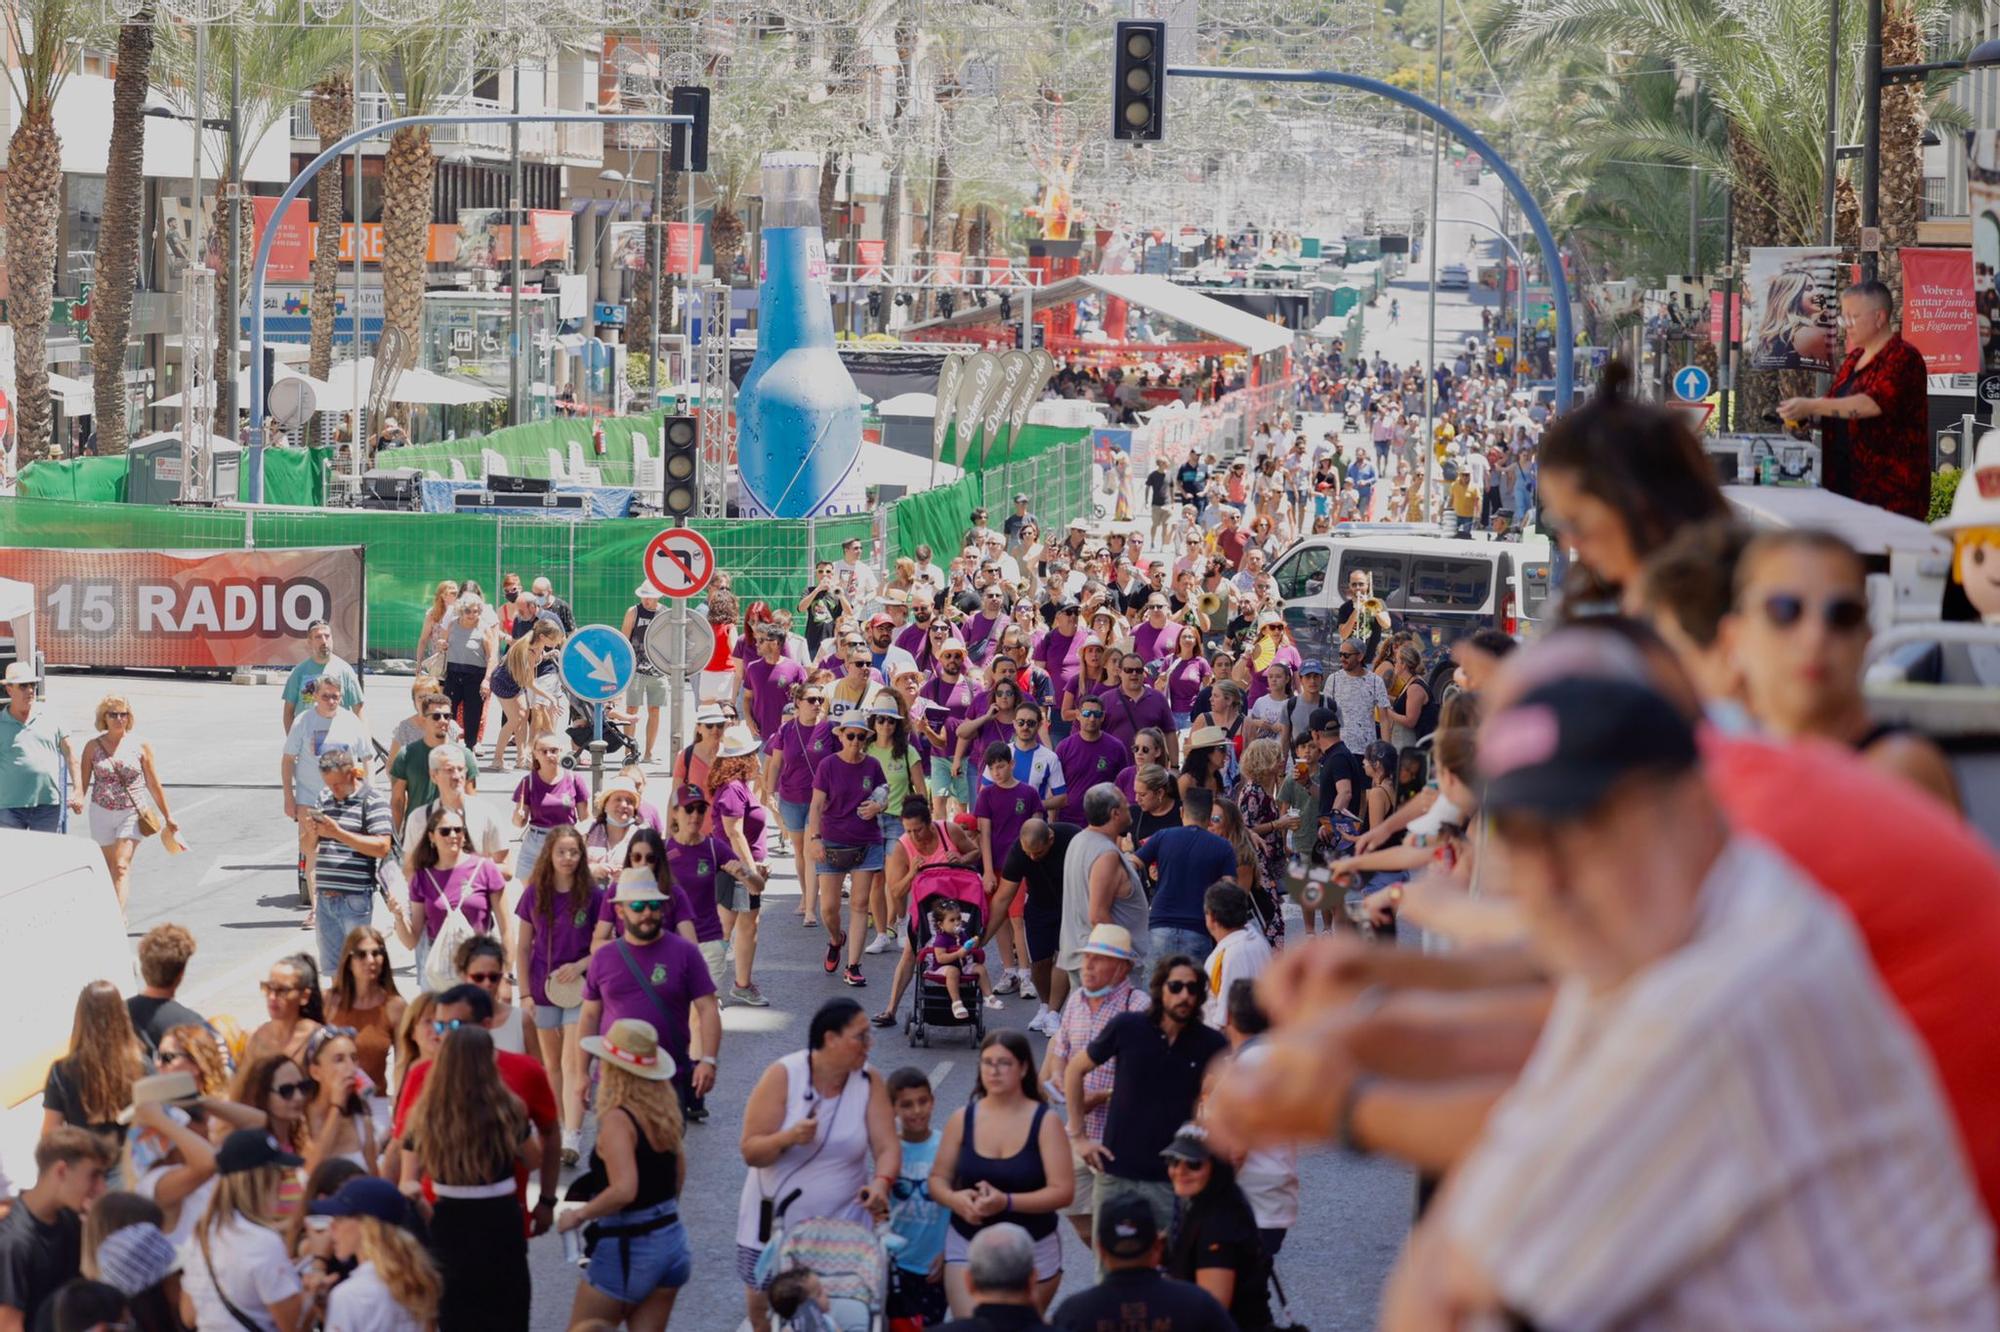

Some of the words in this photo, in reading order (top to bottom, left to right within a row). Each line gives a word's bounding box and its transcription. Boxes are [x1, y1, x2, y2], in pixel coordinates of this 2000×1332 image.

[1921, 285, 1955, 296] Volver
[1956, 288, 1963, 296] a
[1909, 297, 1943, 307] cantar
[1943, 297, 1975, 309] juntos
[1923, 308, 1933, 319] la
[1934, 307, 1958, 319] llum
[1959, 309, 1974, 320] de
[1911, 321, 1925, 332] les
[1030, 354, 1046, 385] Pub
[959, 390, 984, 442] Dickens
[975, 358, 993, 391] Pub
[985, 386, 1012, 436] Dickens
[1005, 356, 1024, 388] Pub
[47, 584, 115, 631] 15
[138, 584, 325, 632] RADIO
